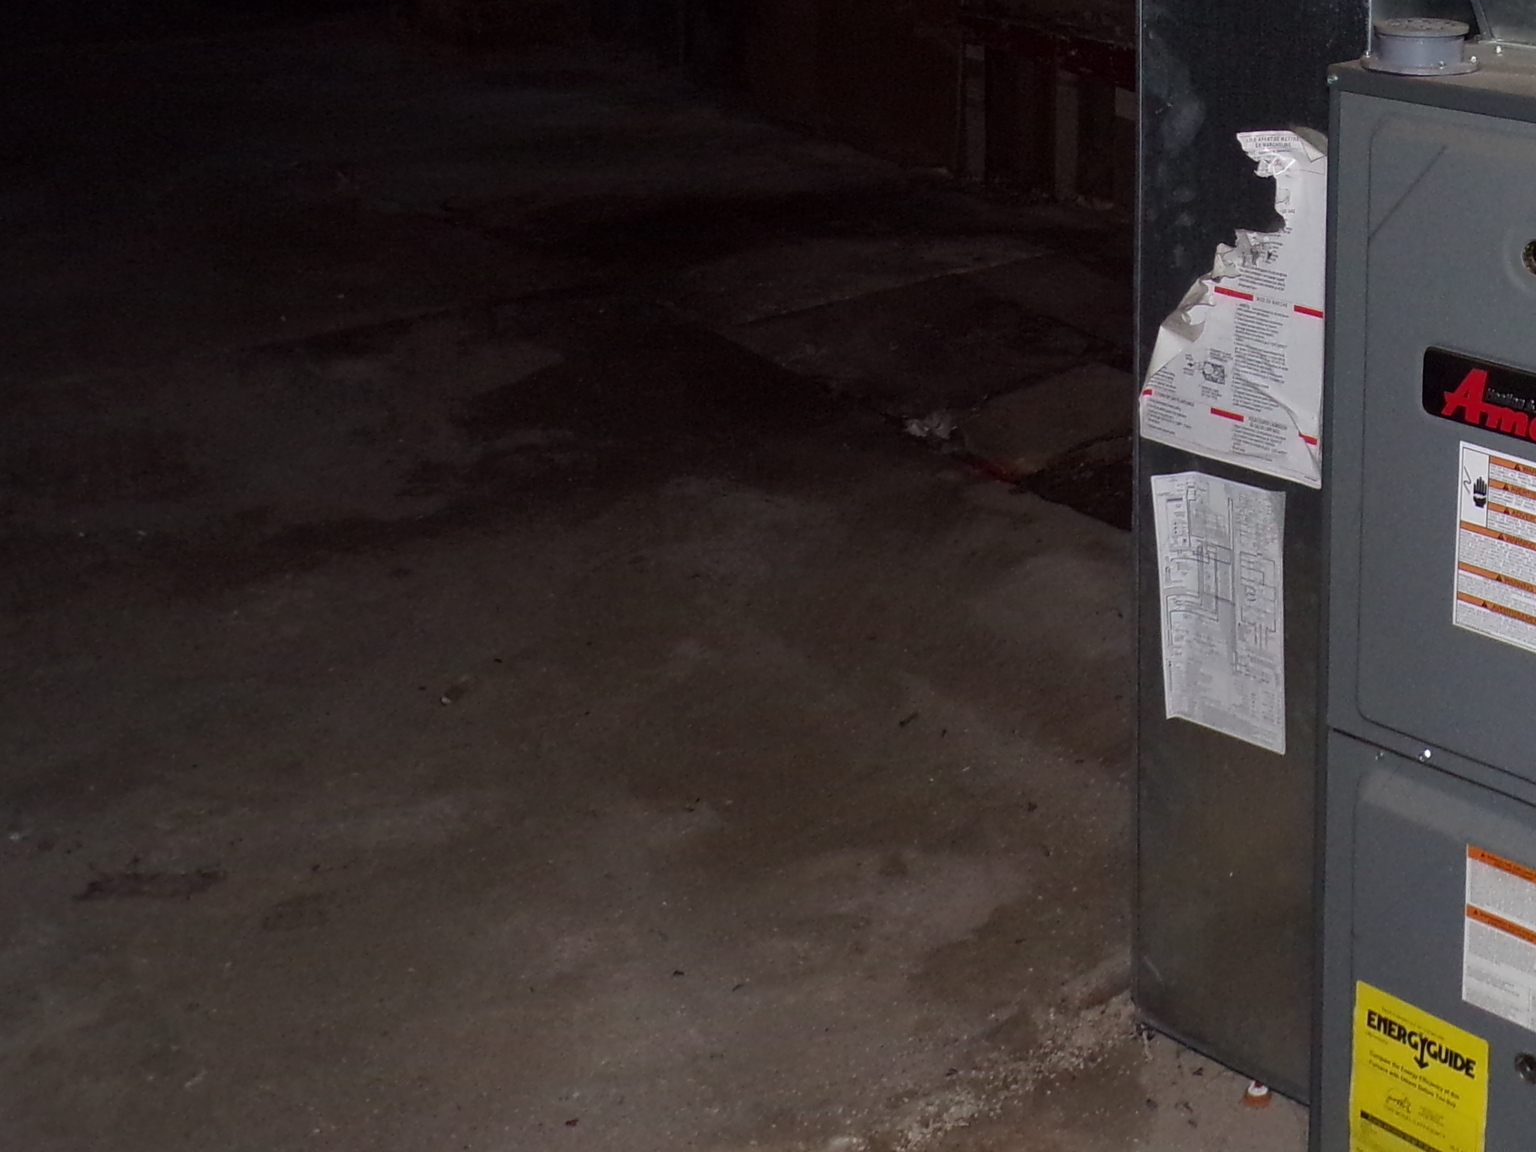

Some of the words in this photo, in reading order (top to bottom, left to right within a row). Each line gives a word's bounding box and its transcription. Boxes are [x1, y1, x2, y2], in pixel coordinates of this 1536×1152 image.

[1486, 387, 1526, 408] Heating
[1525, 399, 1536, 411] &
[1367, 1009, 1477, 1079] ENERGYGUIDE
[1368, 1058, 1388, 1073] Furnace
[1388, 1068, 1399, 1079] with
[1417, 1082, 1434, 1097] Before
[1445, 1097, 1456, 1109] Buy
[1369, 1050, 1391, 1066] Compare
[1400, 1064, 1418, 1080] Energy
[1418, 1073, 1443, 1093] Efficiency
